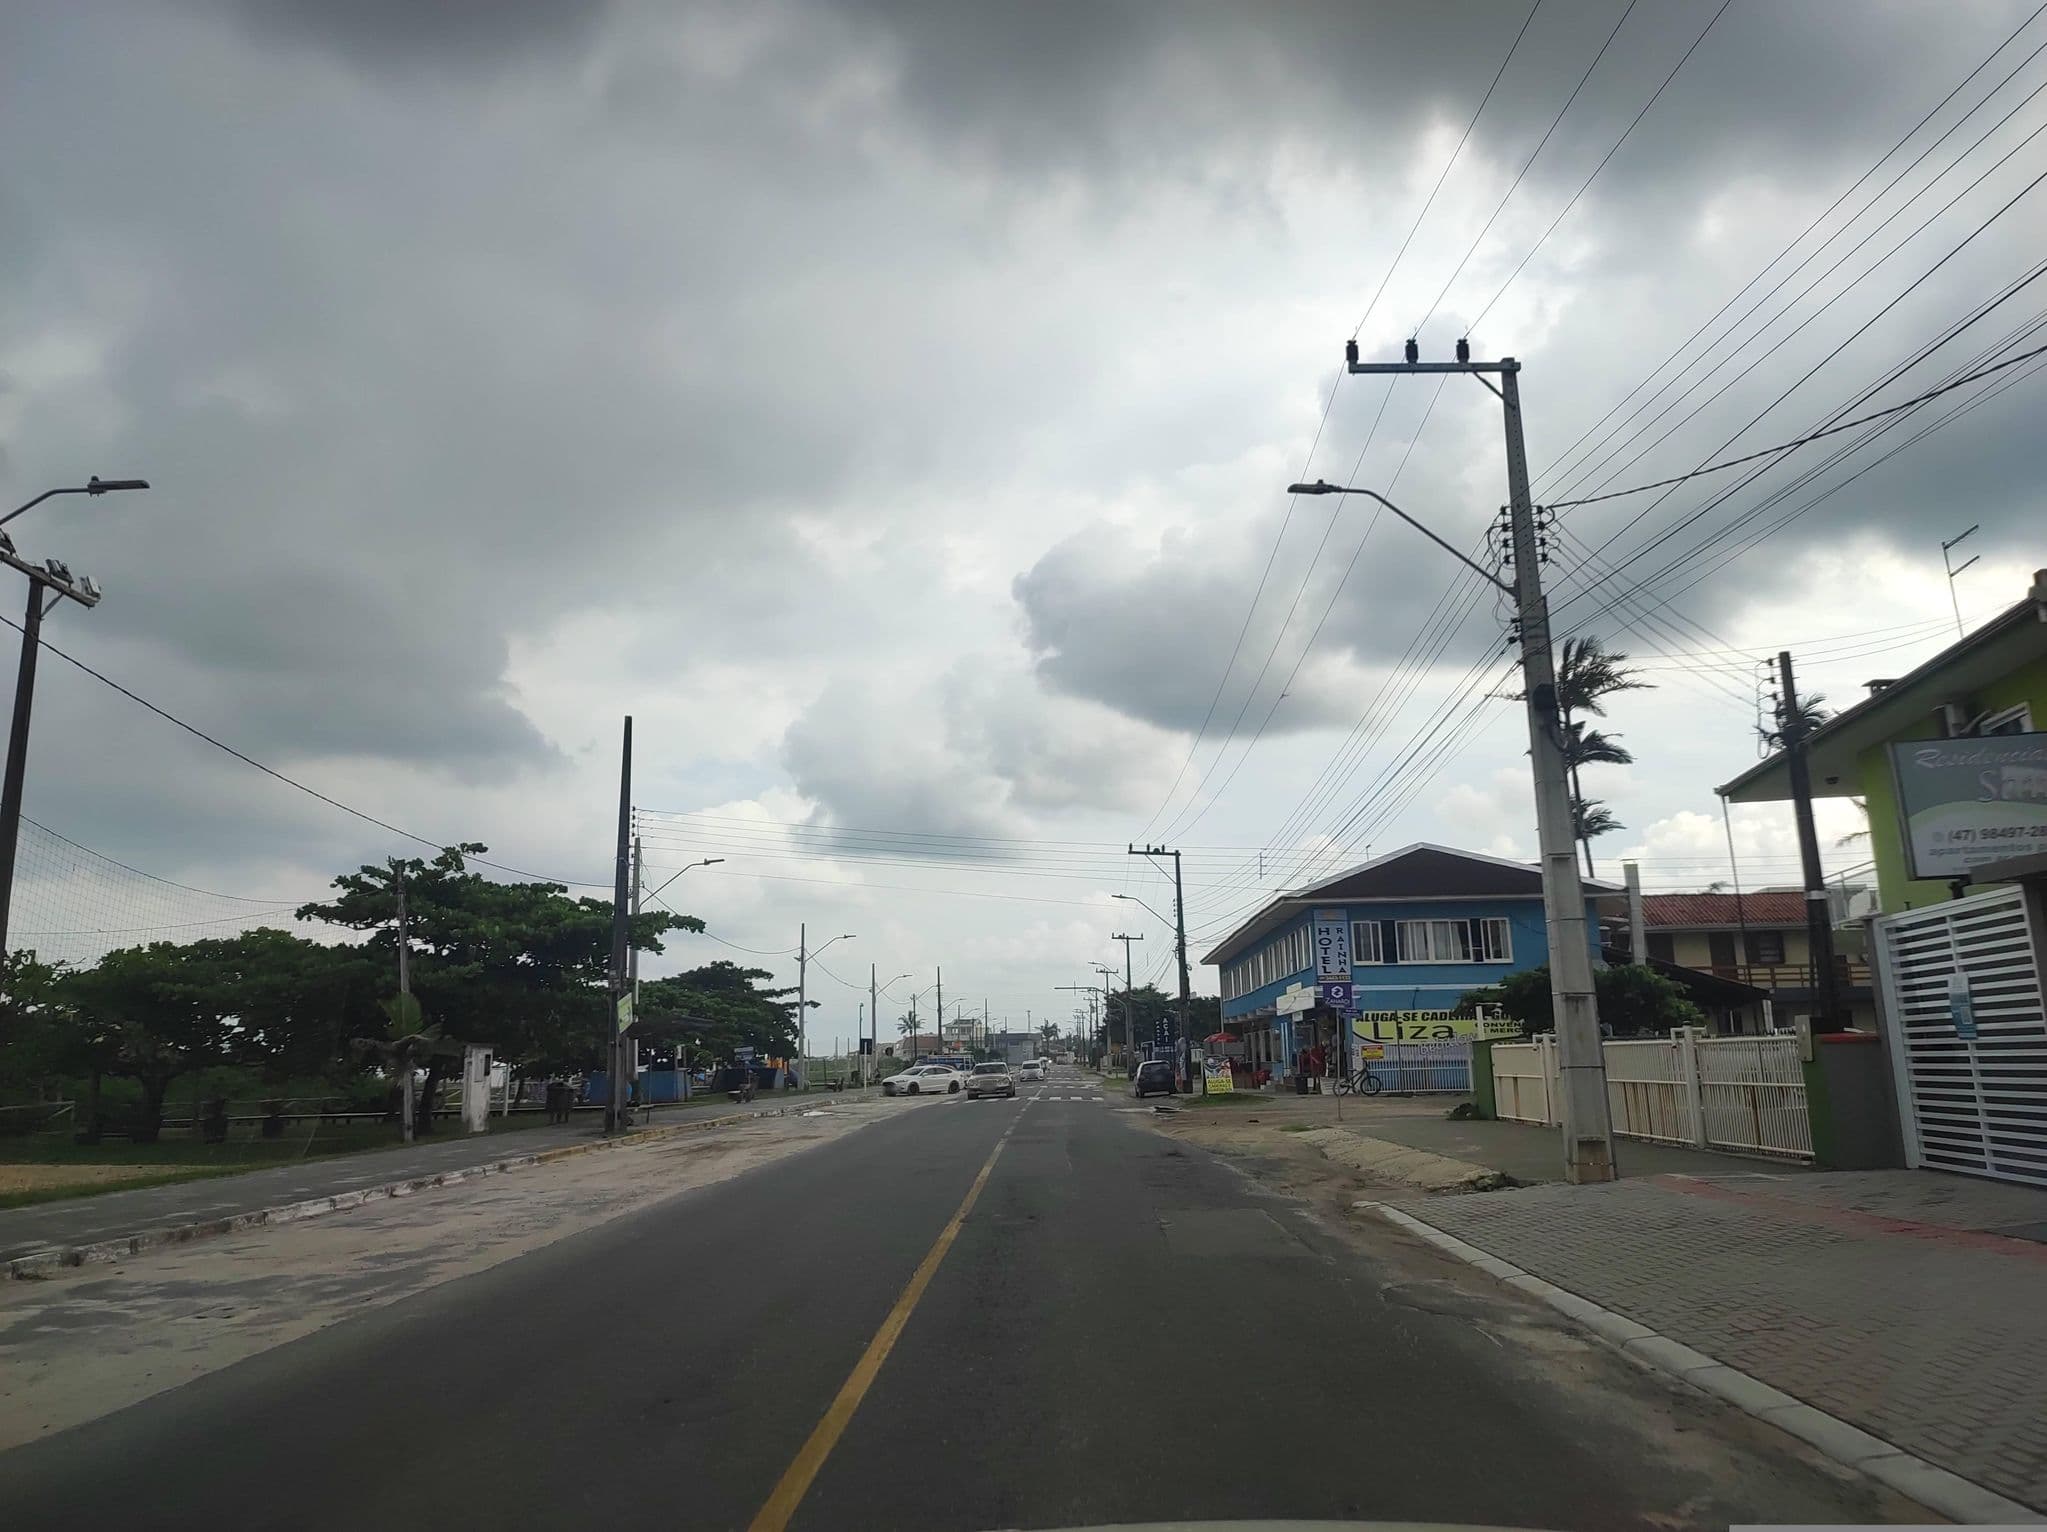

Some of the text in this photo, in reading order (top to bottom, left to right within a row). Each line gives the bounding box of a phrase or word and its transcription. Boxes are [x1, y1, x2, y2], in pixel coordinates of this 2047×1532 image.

[1318, 927, 1333, 974] HOTEL
[1336, 927, 1348, 974] RAINHA
[1373, 1021, 1454, 1040] Liza
